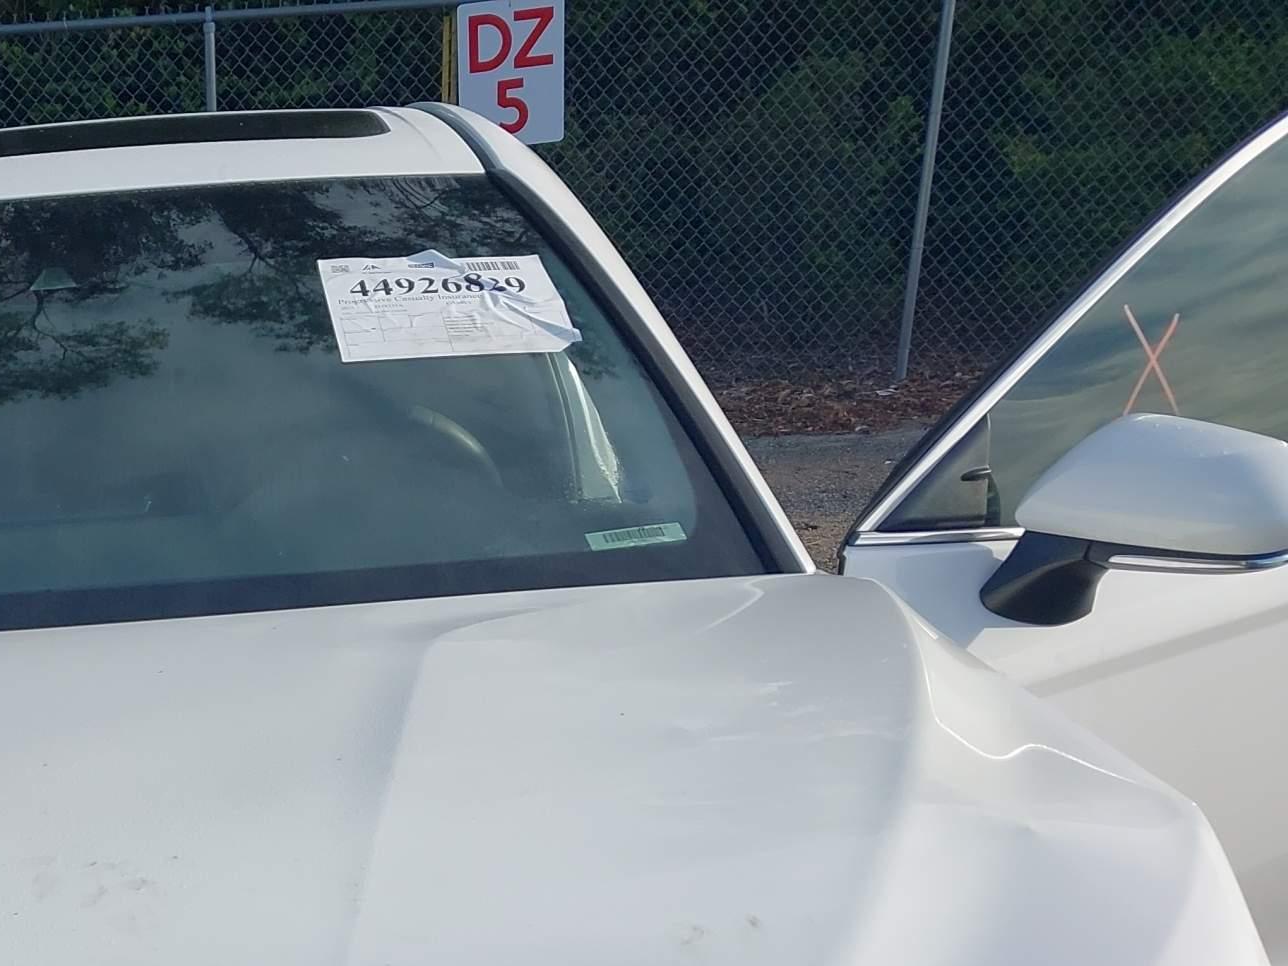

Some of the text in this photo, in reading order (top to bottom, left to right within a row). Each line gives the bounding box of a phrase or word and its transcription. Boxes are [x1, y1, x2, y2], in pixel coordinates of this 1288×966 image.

[468, 6, 554, 73] DZ
[497, 77, 529, 134] 5
[349, 272, 526, 296] 44926829
